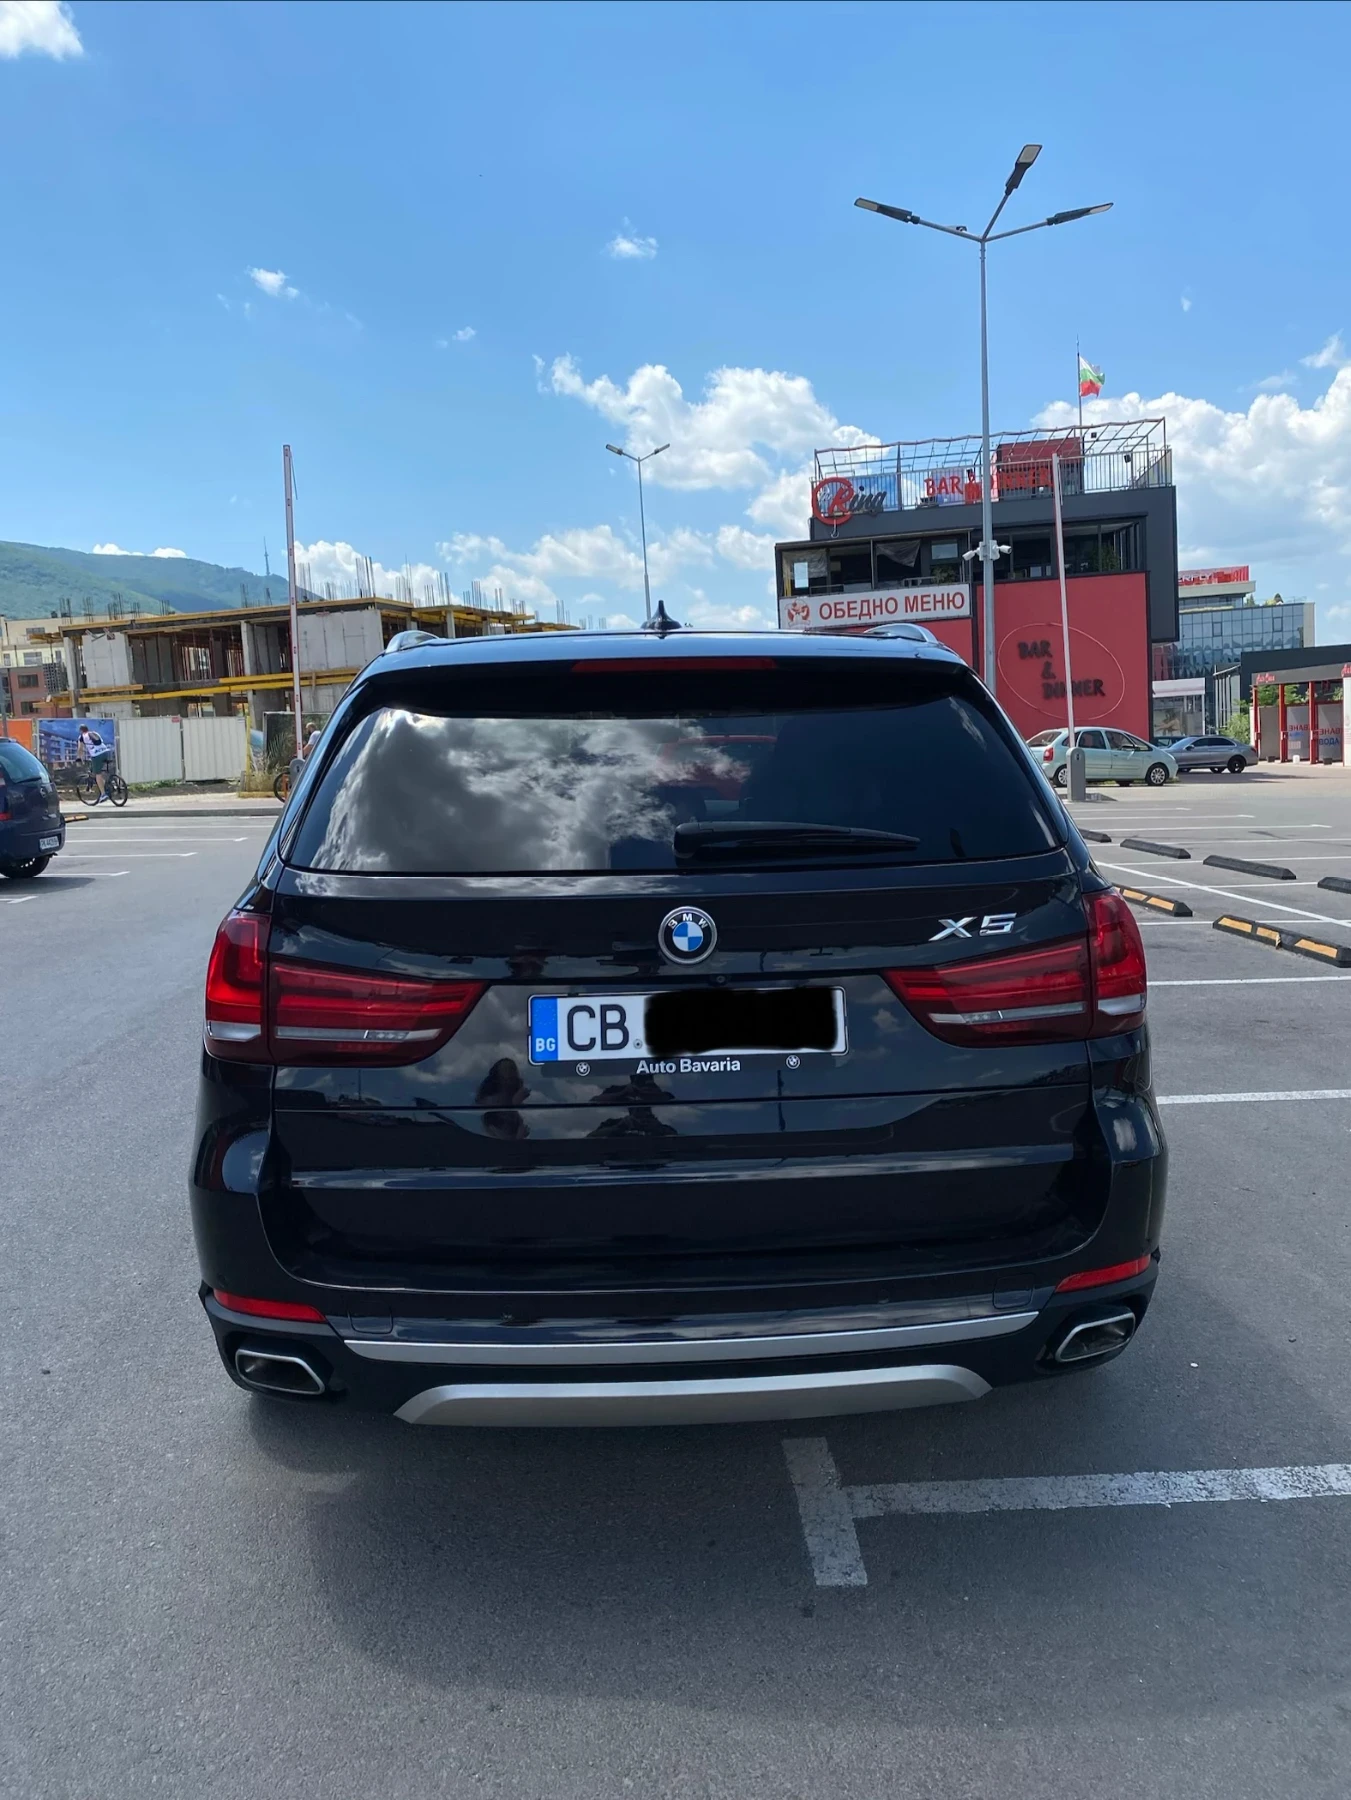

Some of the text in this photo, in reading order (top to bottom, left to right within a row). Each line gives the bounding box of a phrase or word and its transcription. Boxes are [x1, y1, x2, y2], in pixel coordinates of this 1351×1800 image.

[924, 476, 963, 497] BAR
[819, 592, 965, 620] ОБЕДНО МЕНЮ
[1018, 640, 1053, 659] BAR
[668, 913, 708, 929] BMW
[928, 912, 1018, 941] X5
[567, 1003, 630, 1052] CB
[535, 1038, 556, 1052] BG
[636, 1057, 741, 1075] Auto Bavaria
